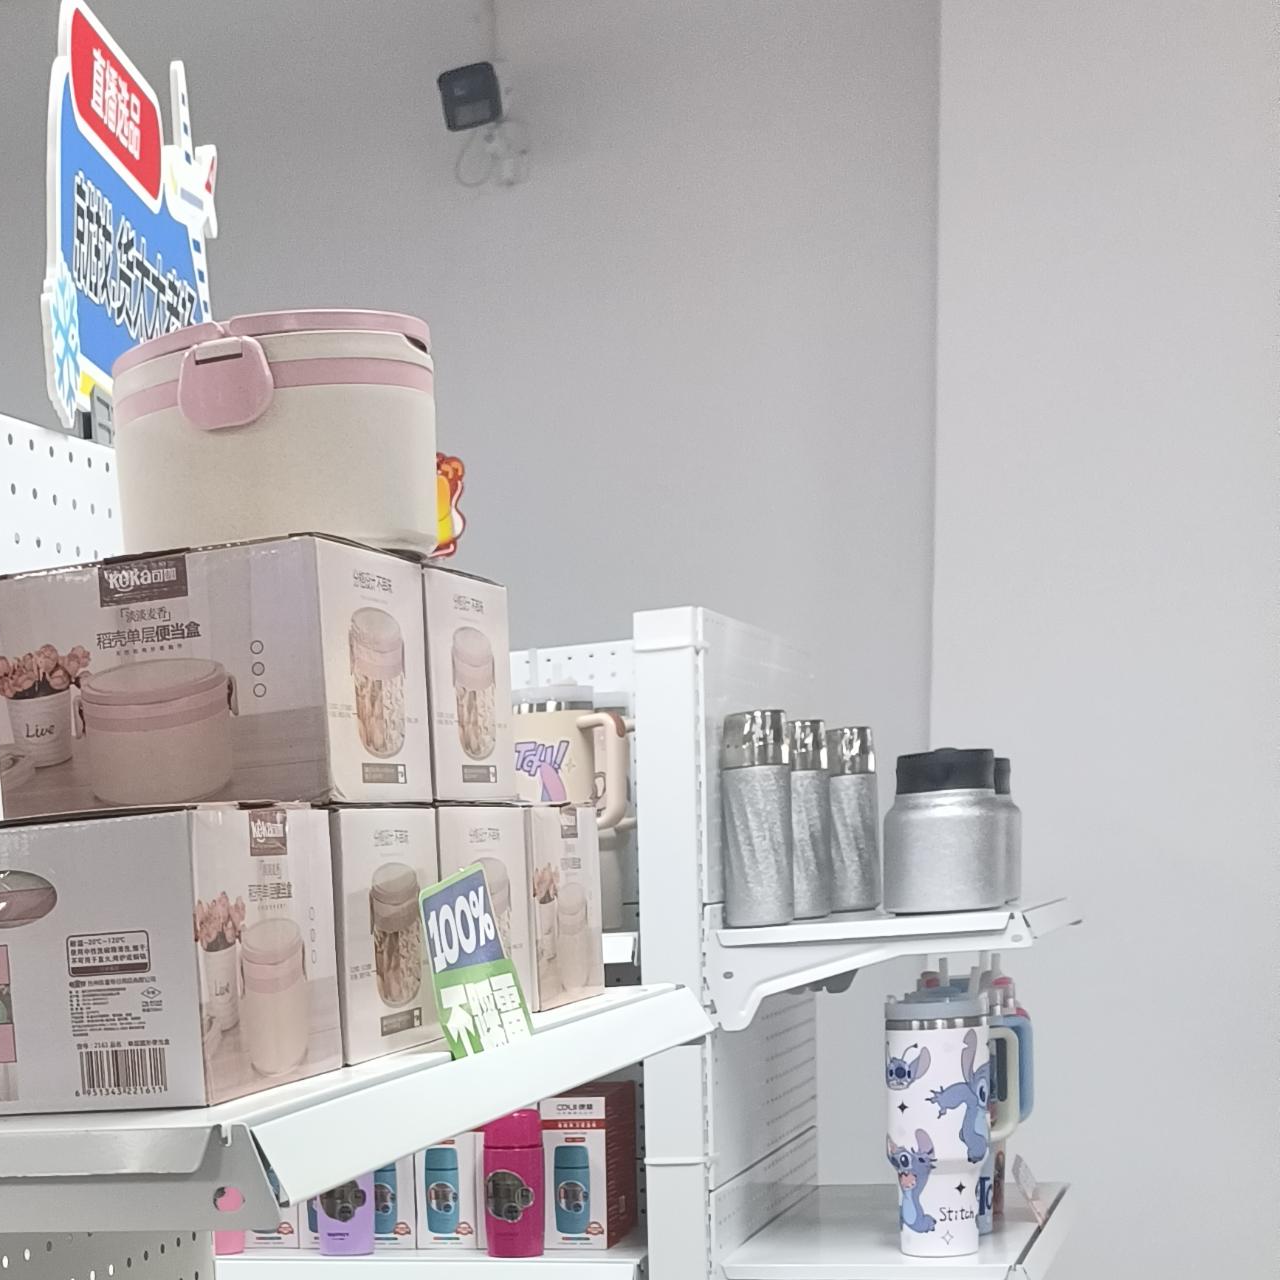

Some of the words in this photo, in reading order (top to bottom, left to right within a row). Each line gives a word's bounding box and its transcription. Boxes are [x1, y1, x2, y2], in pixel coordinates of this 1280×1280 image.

[90, 47, 141, 160] 直播选品
[96, 621, 202, 650] 稻壳单层便当盒
[427, 885, 496, 974] 100%
[939, 1207, 975, 1221] Stitch
